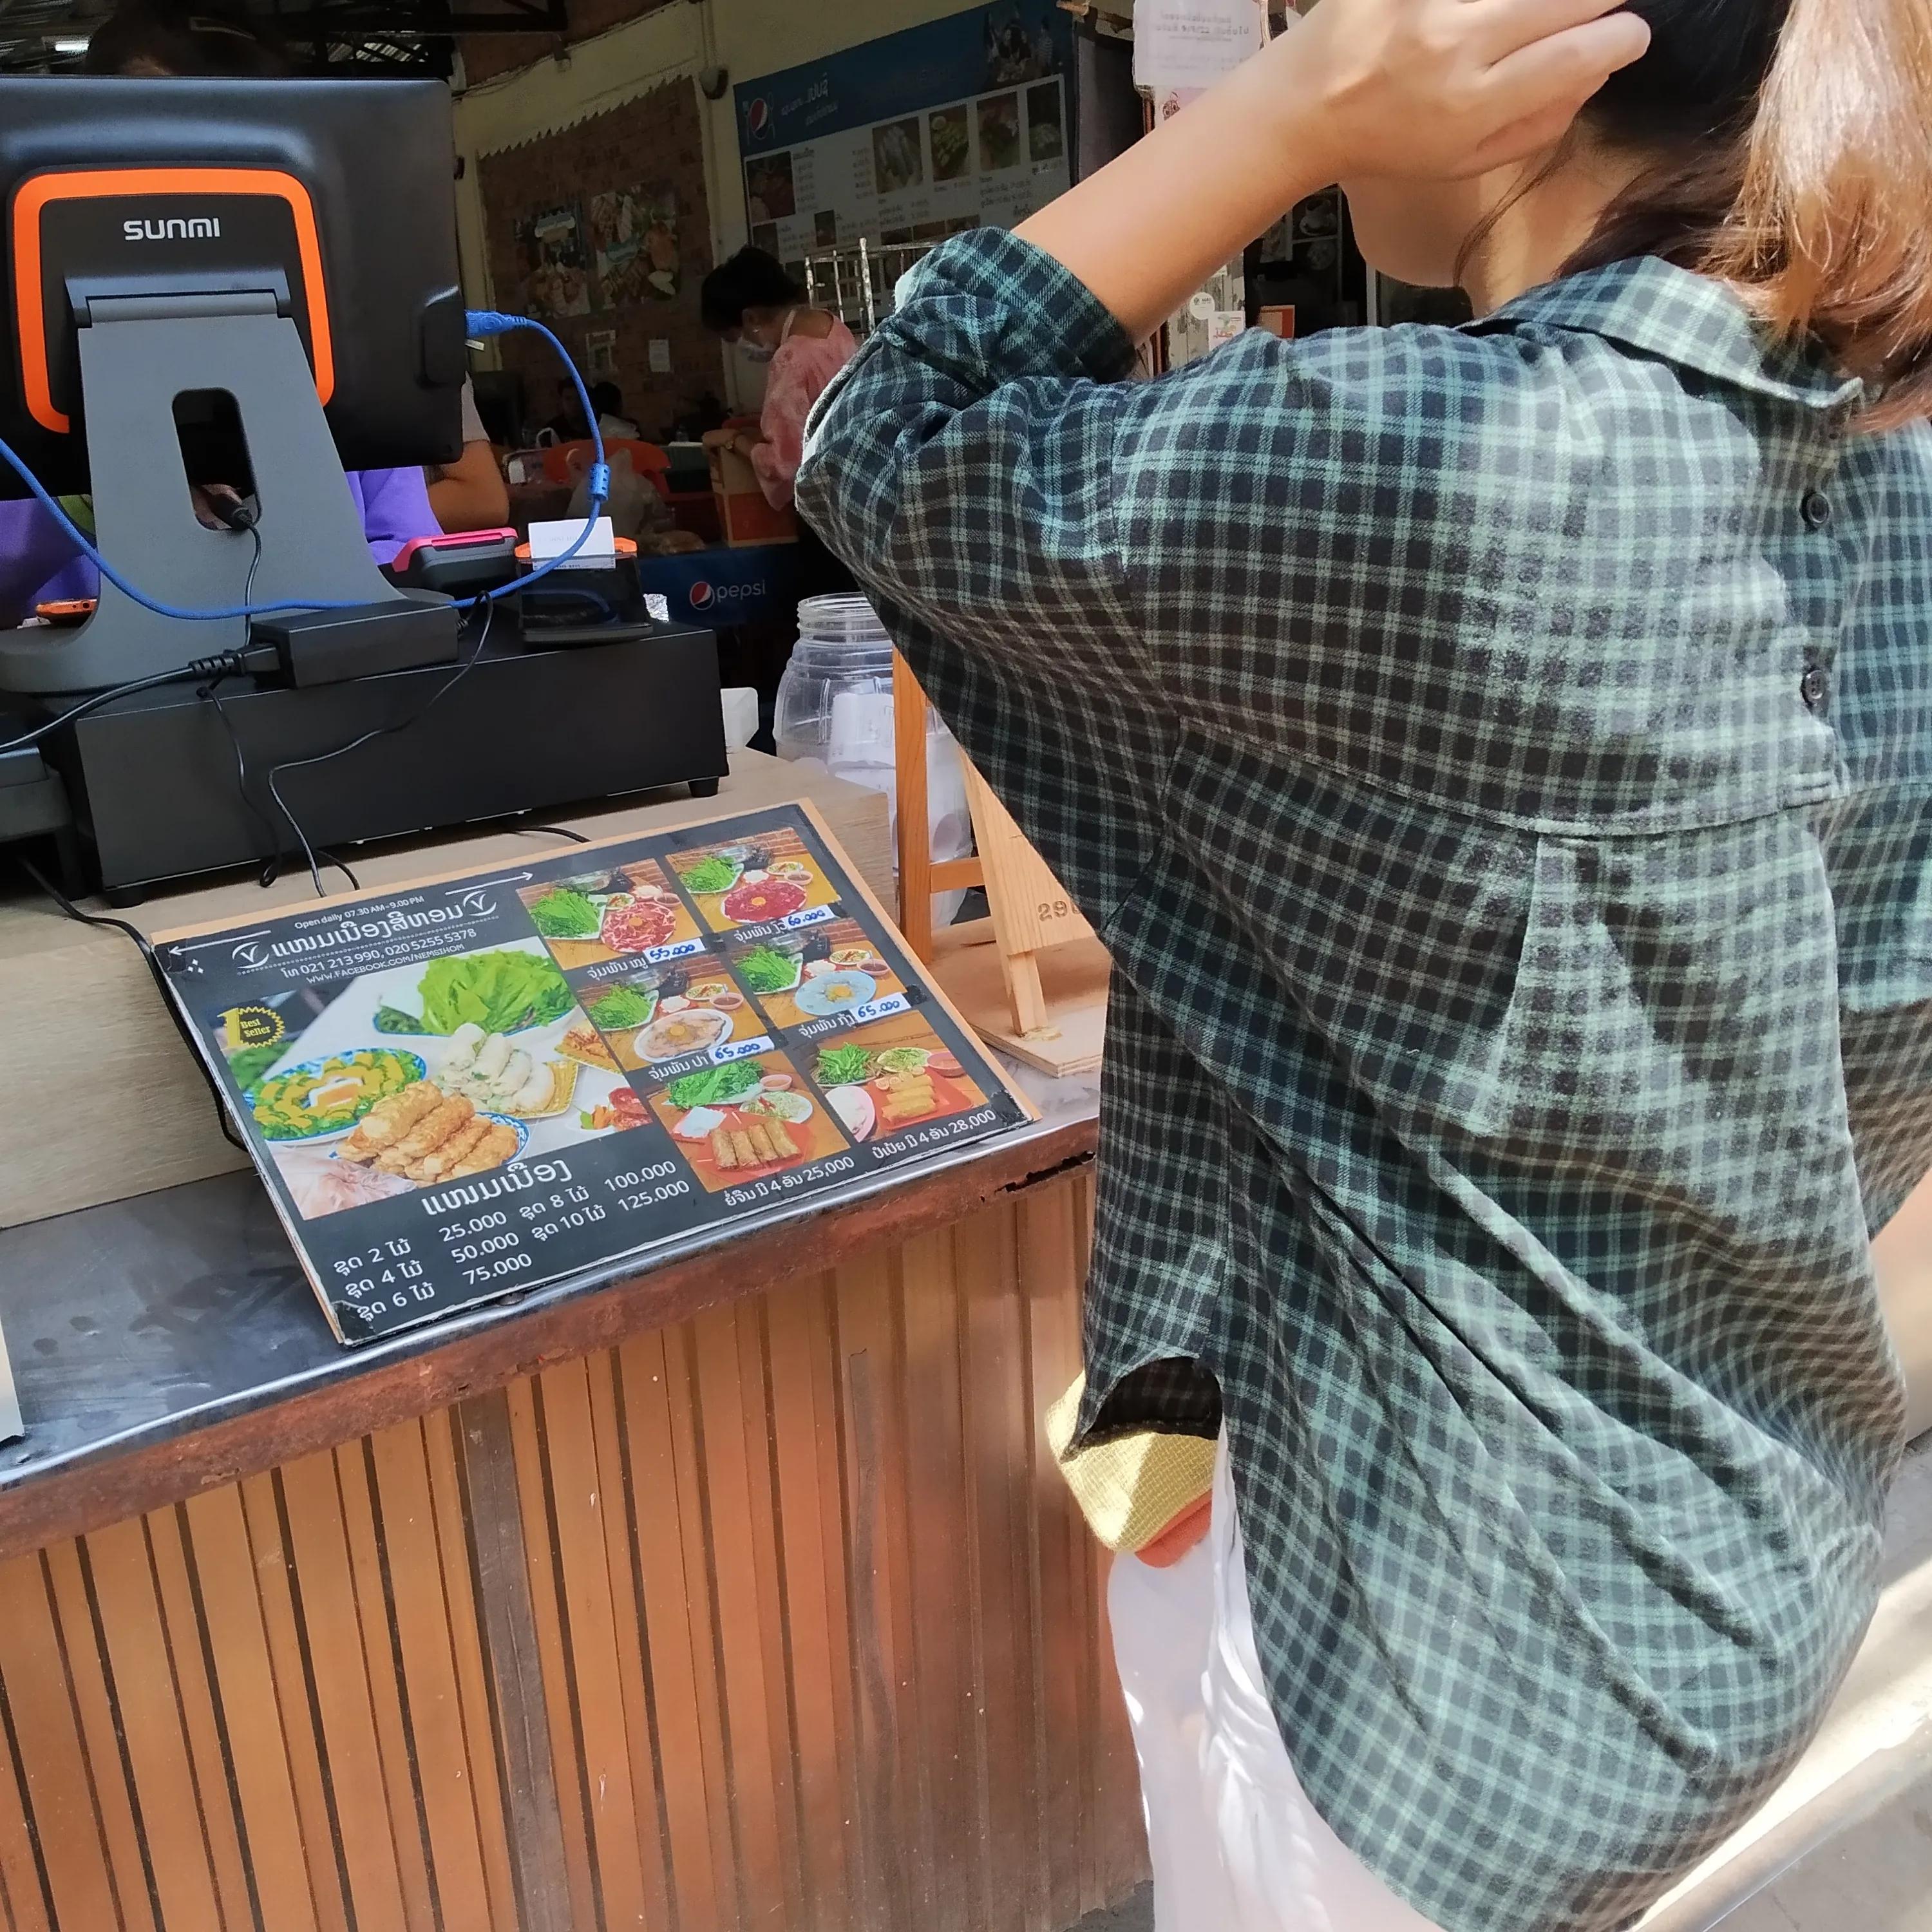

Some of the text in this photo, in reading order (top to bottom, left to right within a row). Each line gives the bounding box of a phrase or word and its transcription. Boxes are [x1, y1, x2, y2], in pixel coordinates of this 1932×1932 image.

[124, 218, 220, 240] SUNMI
[717, 580, 765, 603] pepsi
[294, 919, 321, 929] Open
[321, 914, 342, 923] daily
[344, 907, 370, 918] 07.30
[409, 896, 424, 904] PM
[788, 911, 824, 925] 60.000
[281, 929, 477, 978] ໂທ 021 213 990, 020 5255 5378
[240, 1018, 261, 1029] Best
[858, 1002, 900, 1017] 65.000
[692, 1056, 708, 1067] ປາ
[715, 1043, 760, 1059] 65.000
[904, 1134, 918, 1148] ມີ
[920, 1132, 929, 1142] 4
[929, 1127, 949, 1140] ອັນ
[519, 1161, 676, 1220] ຊຸດ 8 ໄມ້ 100.000
[755, 1182, 769, 1197] ມີ
[771, 1180, 781, 1190] 4
[782, 1175, 803, 1188] ອັນ
[804, 1157, 854, 1181] 25,000
[531, 1180, 689, 1241] ຊຸດ 10 ໄມ້ 125.000
[334, 1211, 507, 1276] ຊຸດ 2 ໄມ້ 25.000
[345, 1233, 519, 1298] ຊຸດ 4 ໄມ້ 50.000
[357, 1253, 532, 1321] ຊຸດ 6 ໄມ້ 75.000
